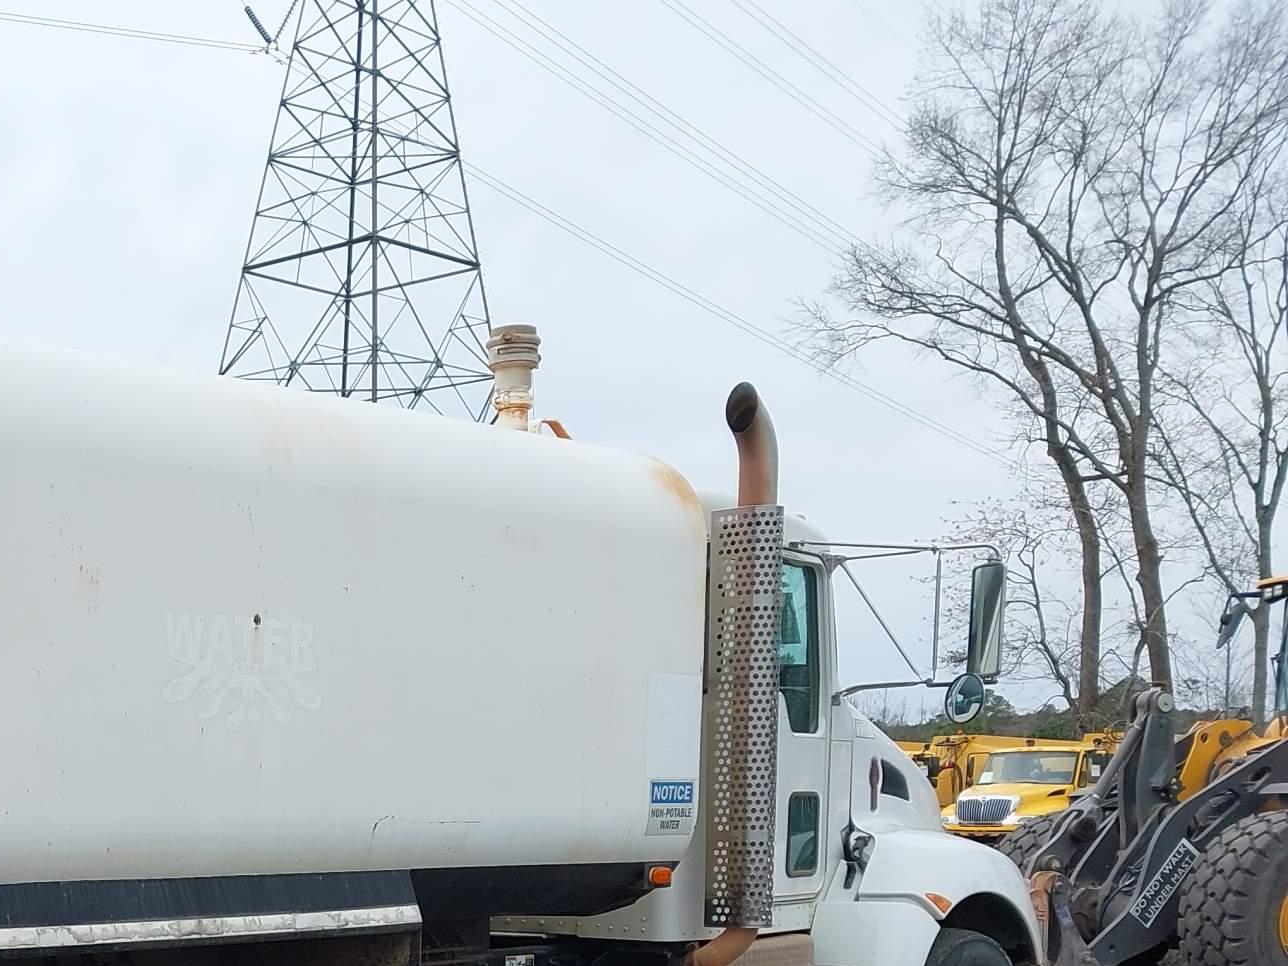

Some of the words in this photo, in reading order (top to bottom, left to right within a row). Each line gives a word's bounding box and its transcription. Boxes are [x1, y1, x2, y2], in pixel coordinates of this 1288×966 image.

[653, 785, 693, 801] NOTICE
[651, 807, 693, 818] NON-POTABLE
[659, 820, 681, 830] WATER
[1133, 897, 1148, 917] DO
[1146, 875, 1165, 900] NOT
[1163, 842, 1189, 874] WALK
[1145, 883, 1175, 919] UNDER
[1172, 854, 1194, 884] MAST
